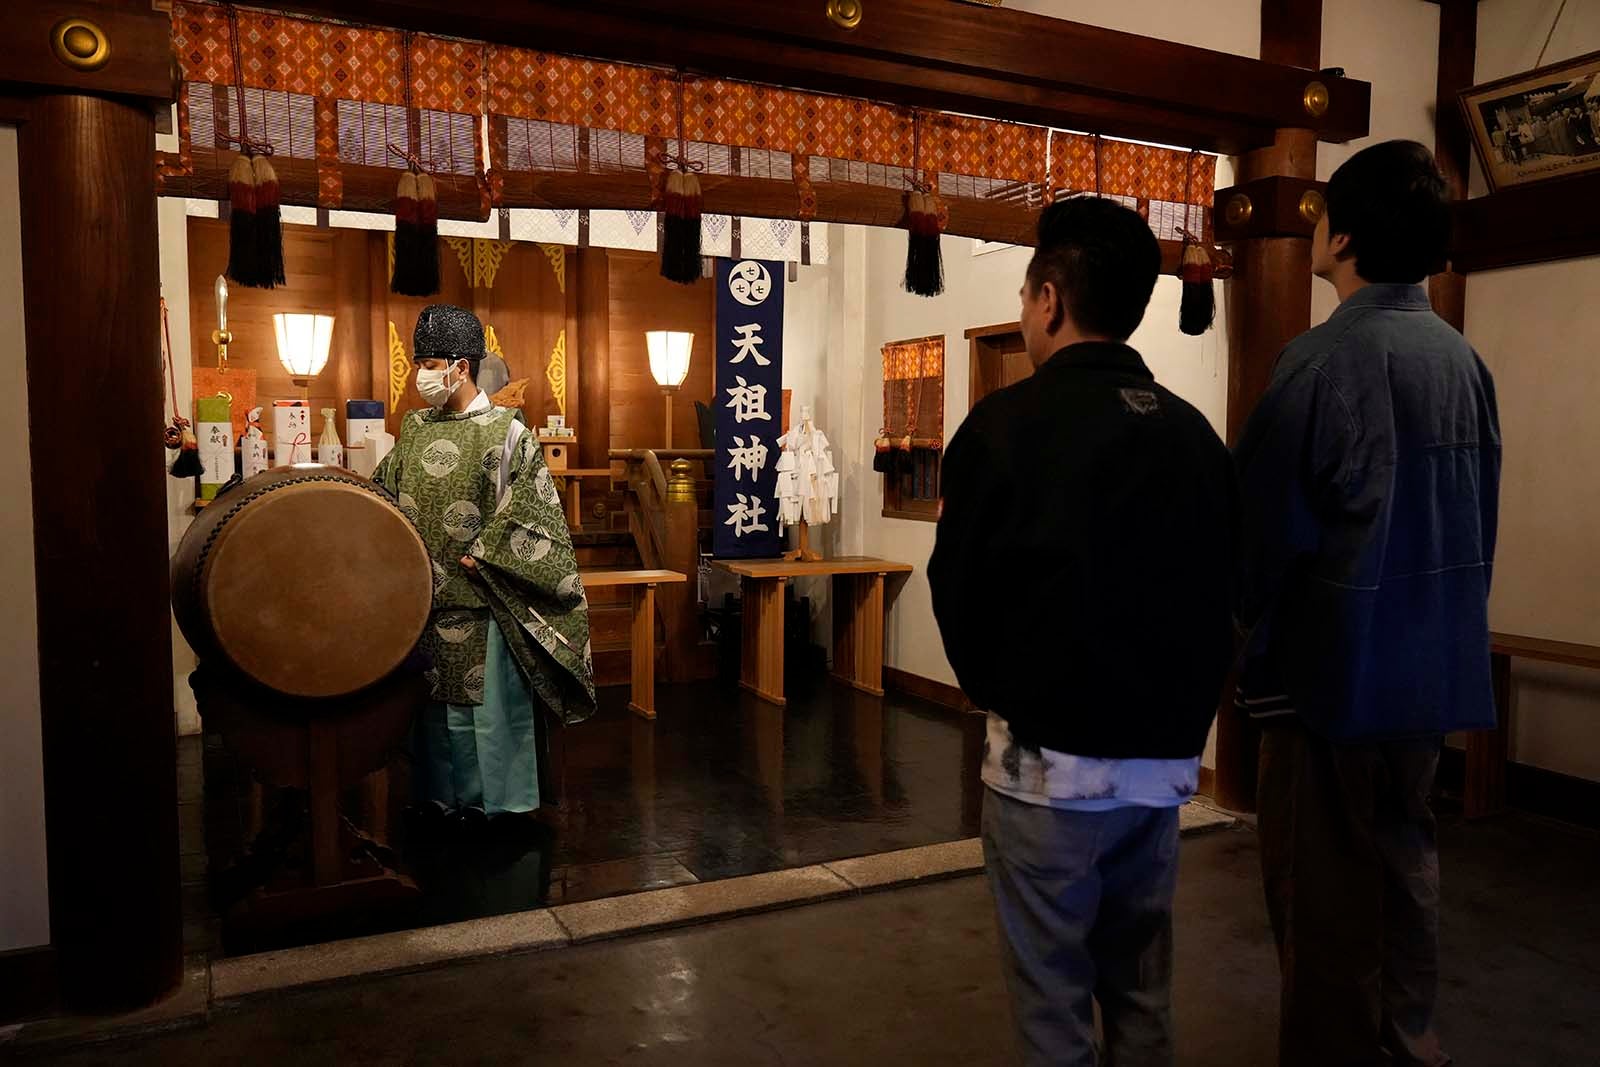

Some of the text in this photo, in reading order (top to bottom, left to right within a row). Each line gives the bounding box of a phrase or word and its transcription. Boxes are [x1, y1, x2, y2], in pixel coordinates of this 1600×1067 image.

[746, 266, 755, 276] 七
[736, 284, 745, 293] 七
[756, 285, 764, 294] 七
[724, 322, 772, 538] 天祖神社
